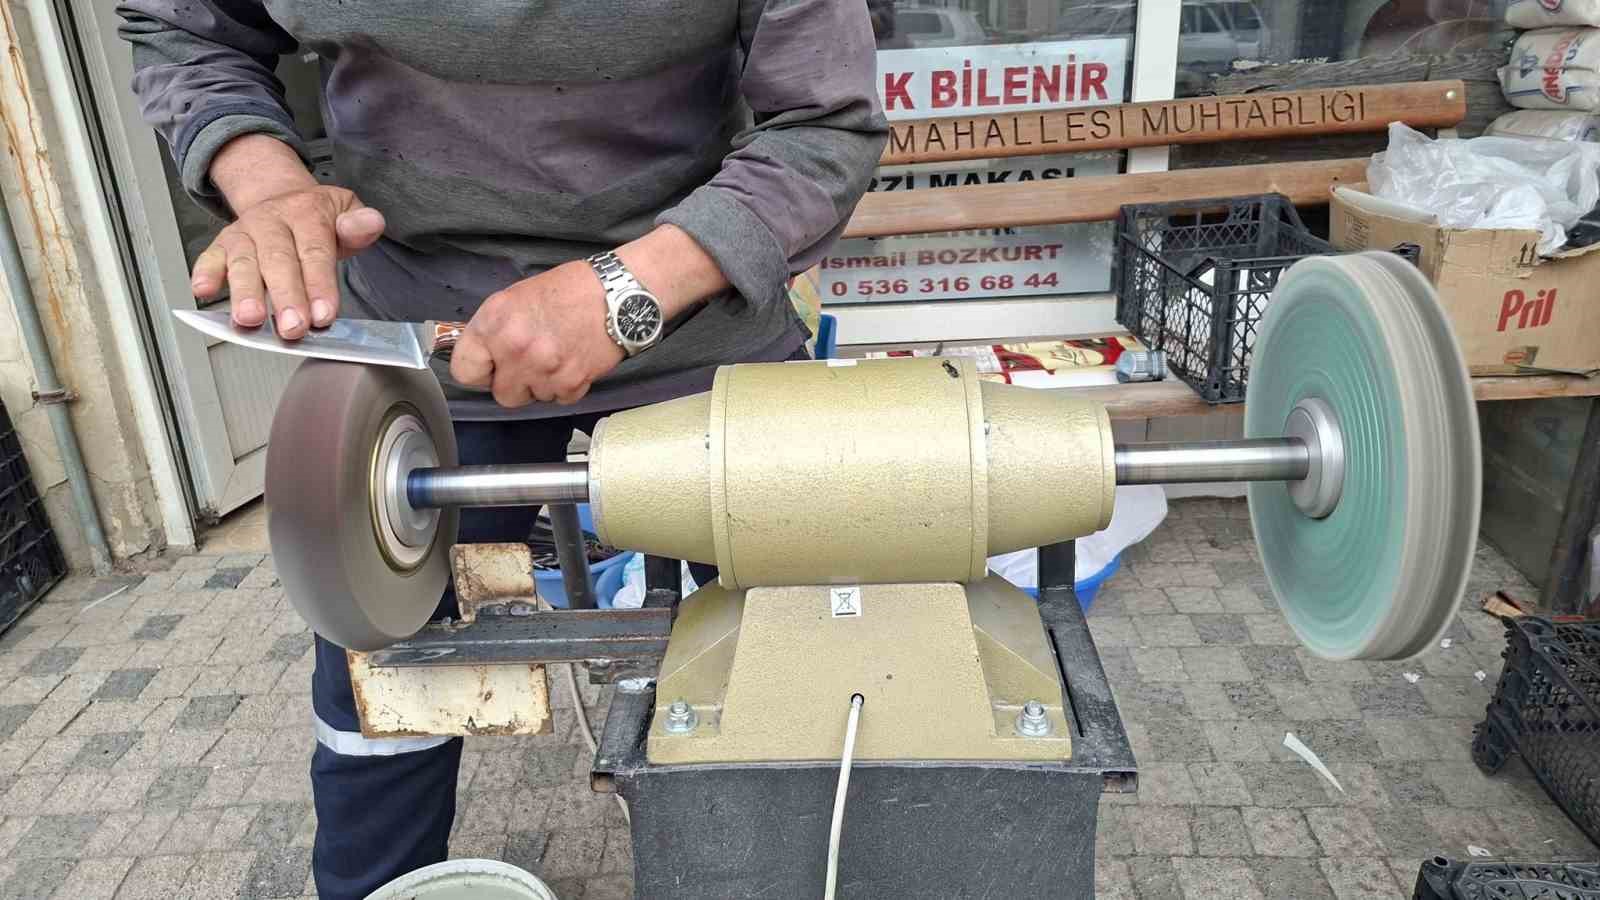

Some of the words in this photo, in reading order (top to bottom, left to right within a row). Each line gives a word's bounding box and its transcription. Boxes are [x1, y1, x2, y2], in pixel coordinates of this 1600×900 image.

[885, 72, 915, 110] K
[931, 54, 1109, 108] BİLENİR
[917, 244, 1063, 266] BOZKURT
[832, 281, 848, 297] 0
[857, 279, 909, 295] 536
[919, 276, 970, 293] 316
[980, 274, 1014, 290] 68
[1024, 272, 1059, 288] 44
[1496, 288, 1557, 332] Pril
